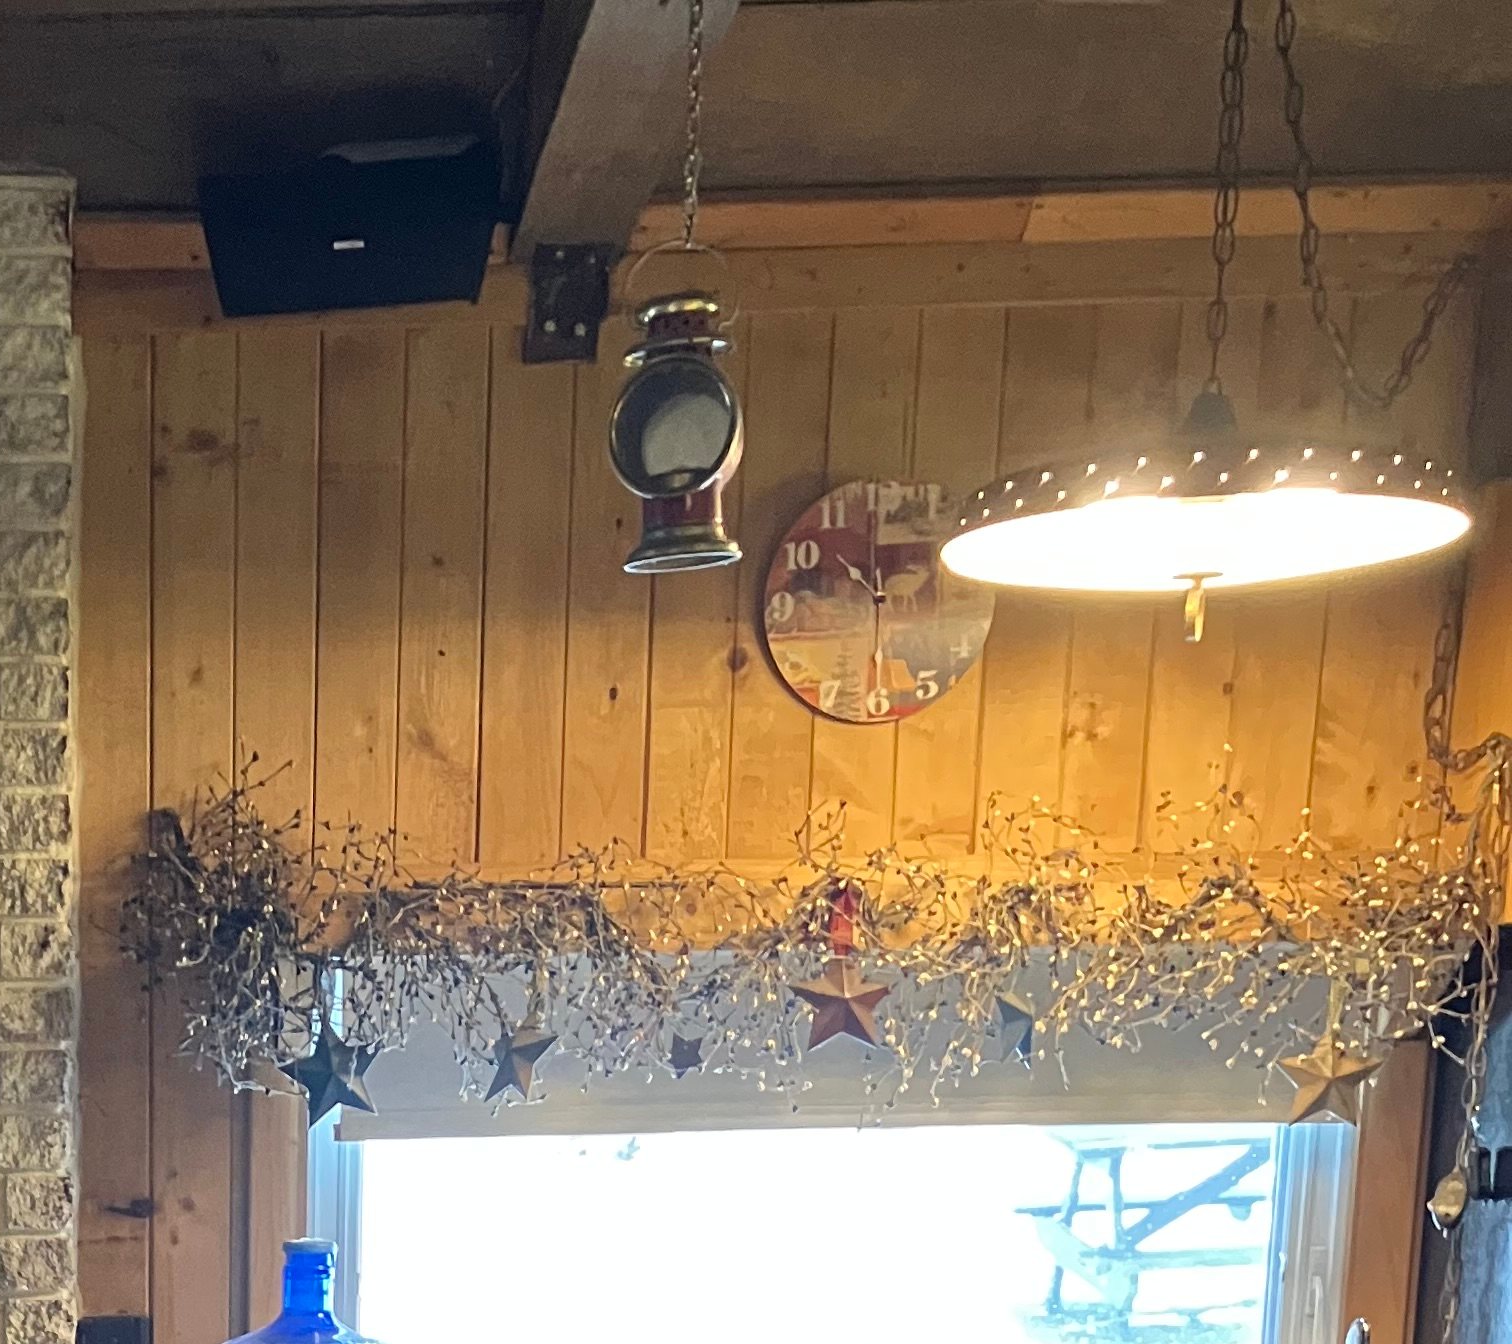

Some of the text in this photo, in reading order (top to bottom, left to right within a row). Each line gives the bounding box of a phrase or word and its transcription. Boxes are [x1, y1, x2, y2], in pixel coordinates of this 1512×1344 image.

[818, 498, 846, 529] 11
[785, 540, 820, 570] 10
[772, 591, 794, 621] 9
[819, 680, 841, 708] 7
[915, 670, 939, 700] 5
[867, 688, 890, 716] 6
